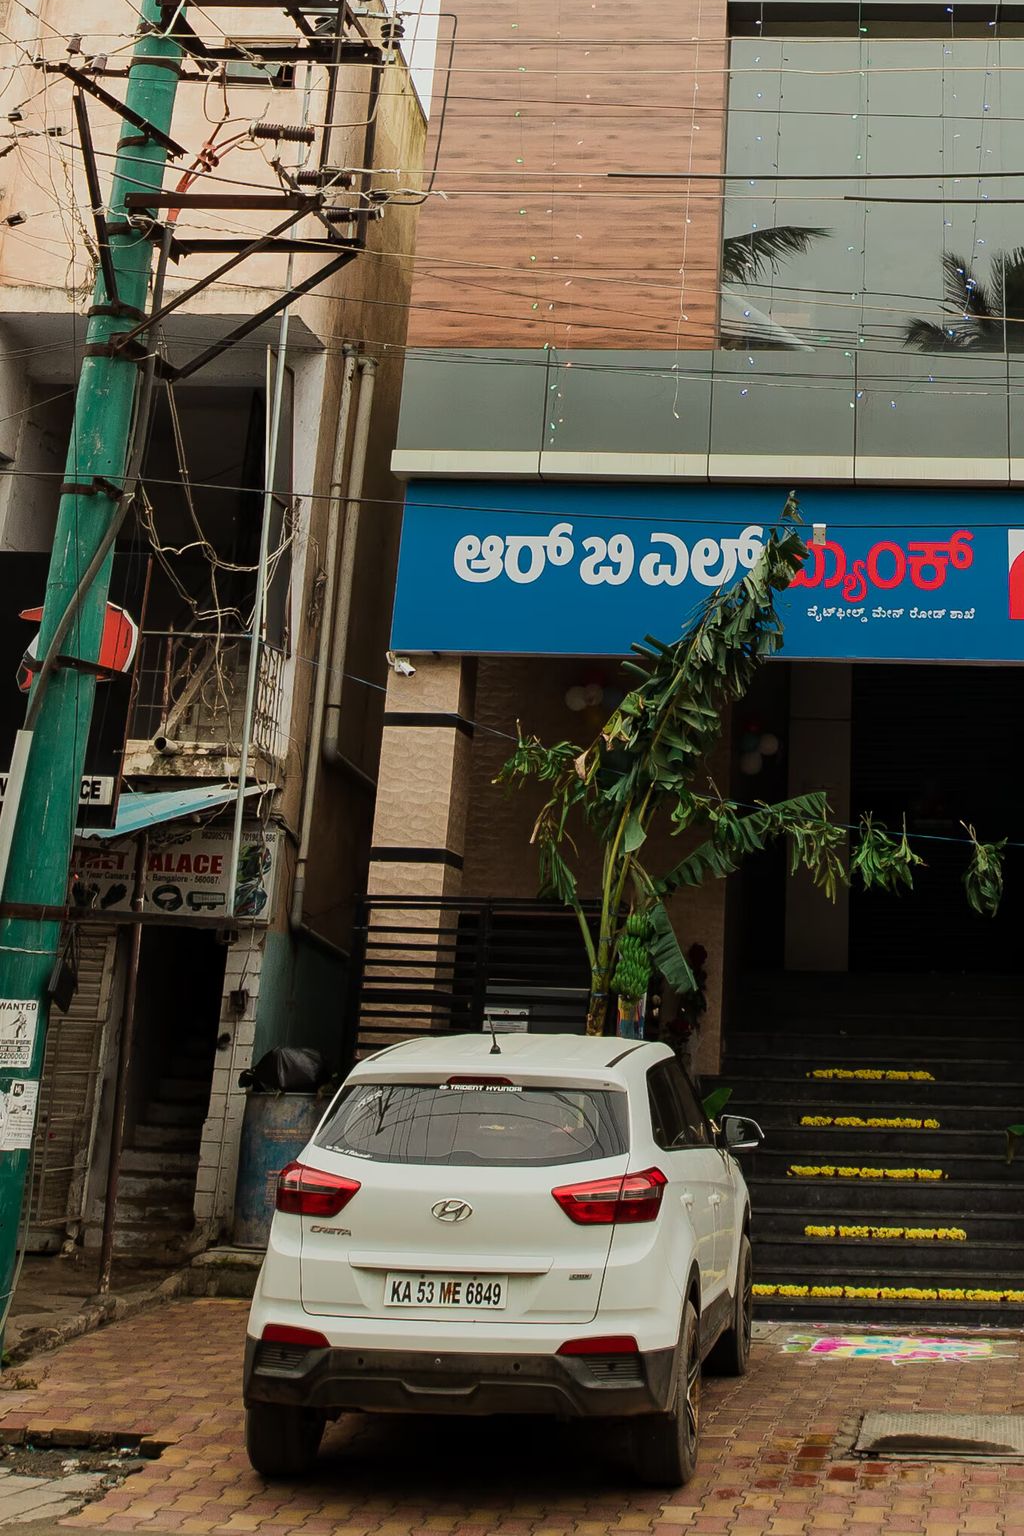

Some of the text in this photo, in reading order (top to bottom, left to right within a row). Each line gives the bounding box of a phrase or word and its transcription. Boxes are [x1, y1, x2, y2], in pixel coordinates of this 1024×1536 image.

[147, 853, 223, 875] ALACE
[152, 873, 188, 883] Bangalore
[310, 1225, 352, 1237] CRETA
[391, 1281, 501, 1306] KA 53 ME 6849
